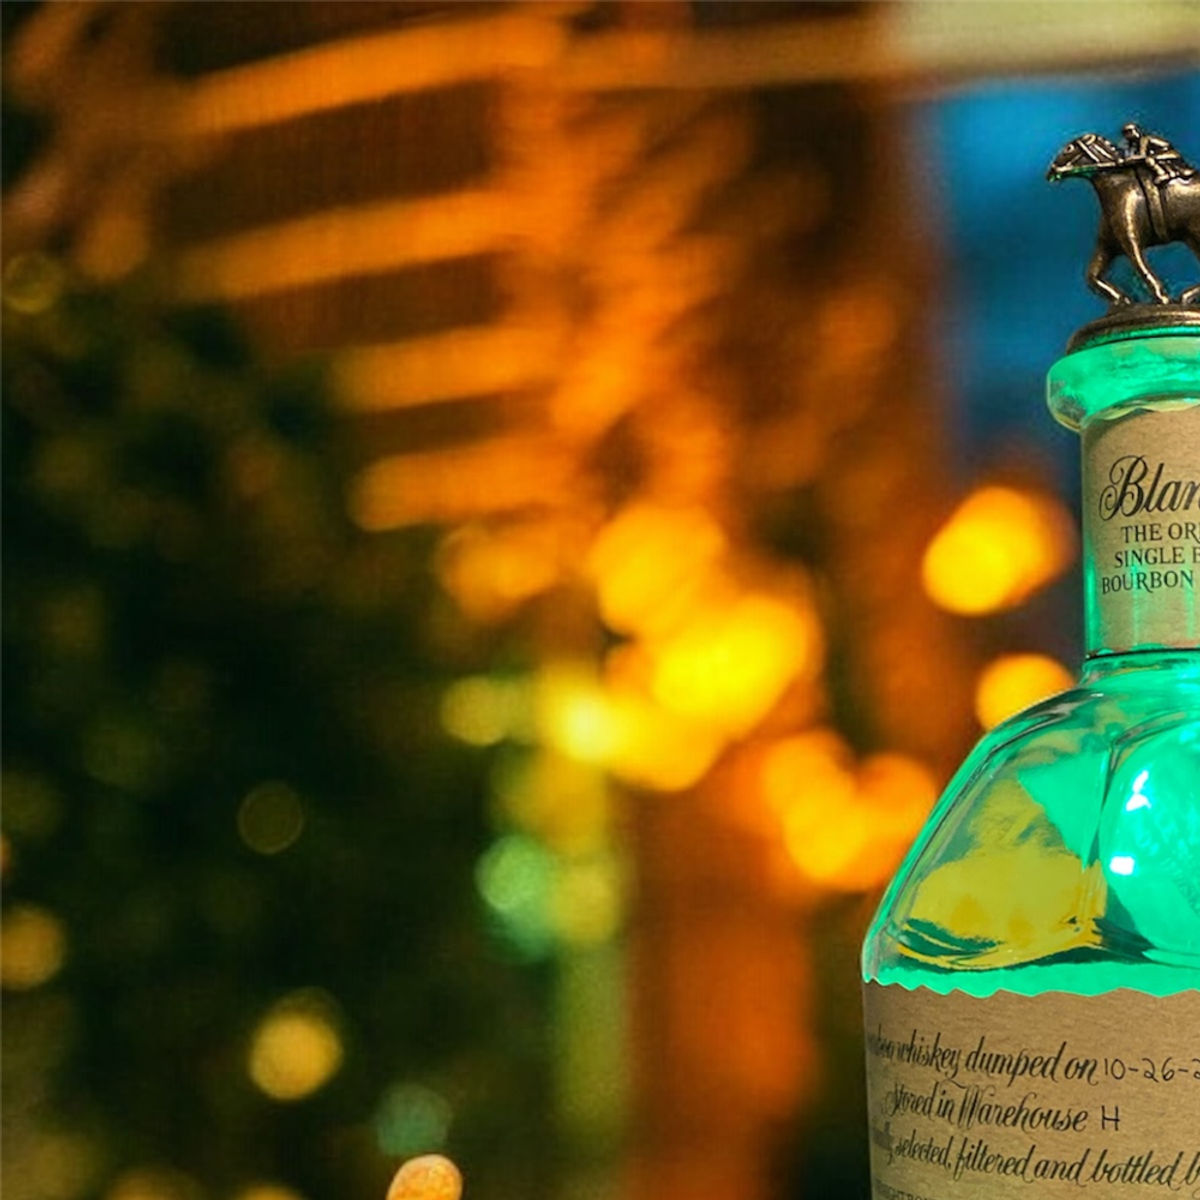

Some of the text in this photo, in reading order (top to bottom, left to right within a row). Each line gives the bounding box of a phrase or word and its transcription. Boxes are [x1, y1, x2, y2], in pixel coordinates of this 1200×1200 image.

[1120, 525, 1163, 544] THE
[1114, 547, 1186, 569] SINGLE
[1101, 570, 1194, 595] BOURBON
[897, 1028, 963, 1081] whiskey
[964, 1037, 1067, 1088] dumped
[1064, 1057, 1100, 1086] on
[936, 1089, 957, 1126] in
[944, 1078, 1089, 1133] Warehouse
[1100, 1105, 1121, 1132] H
[952, 1136, 1037, 1182] filtered
[1033, 1148, 1090, 1188] and
[1088, 1149, 1186, 1192] bottled
